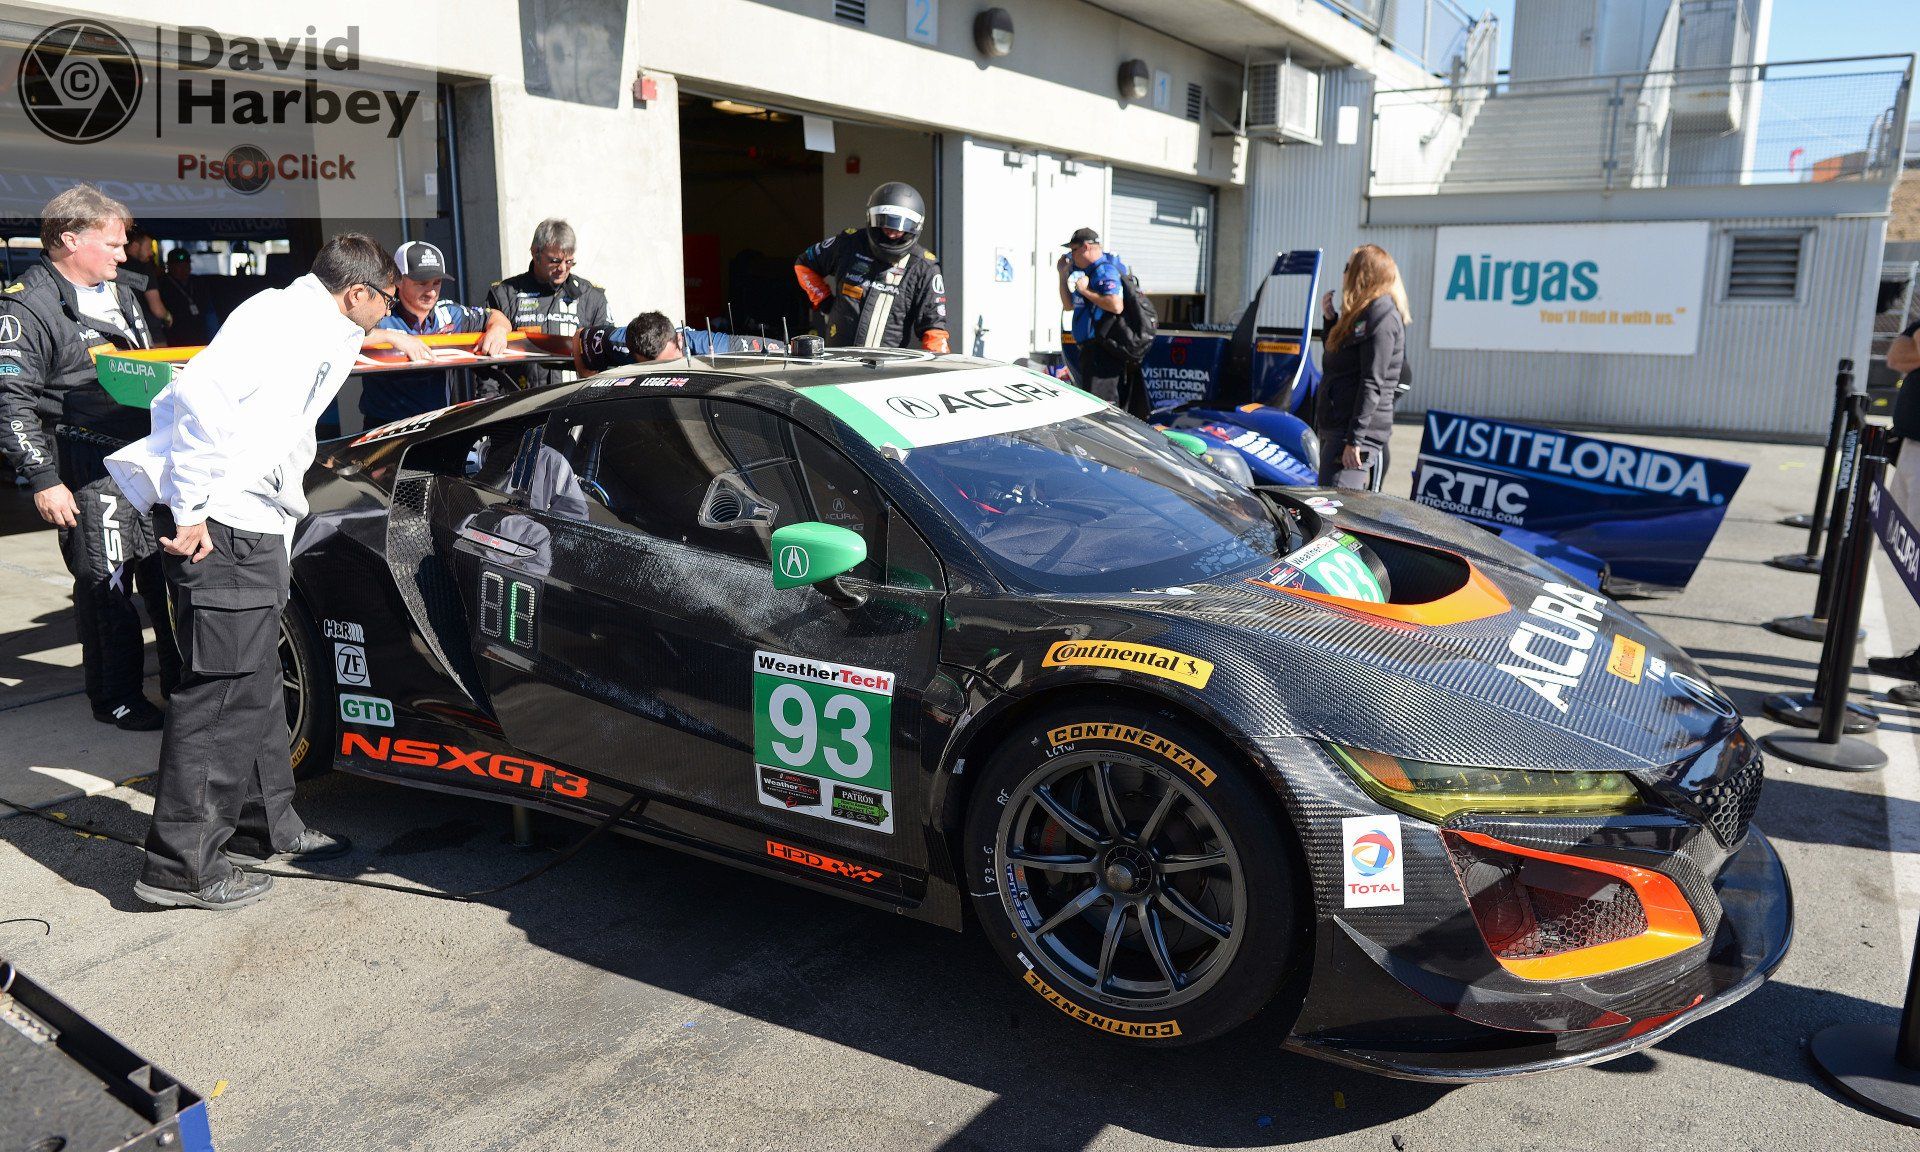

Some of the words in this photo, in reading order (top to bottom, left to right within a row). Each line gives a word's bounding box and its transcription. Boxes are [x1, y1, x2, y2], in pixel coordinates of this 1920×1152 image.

[914, 0, 931, 36] 2
[1160, 78, 1167, 96] 1
[1446, 254, 1600, 306] Airgas
[546, 313, 580, 325] ACURA
[1579, 310, 1606, 325] find
[1609, 310, 1620, 324] it
[1622, 310, 1652, 325] with
[117, 360, 156, 378] ACURA
[1141, 367, 1210, 382] VISITFLORIDA
[1145, 379, 1206, 393] VISITFLORIDA
[938, 383, 1062, 414] ACURA
[1416, 464, 1530, 515] RTIC
[825, 512, 858, 521] ACURA
[99, 493, 125, 596] NSX
[1318, 552, 1386, 604] 93
[1053, 643, 1179, 672] Continental
[1496, 582, 1608, 714] ACURA
[338, 653, 364, 675] ZF
[758, 655, 890, 691] WeatherTech
[343, 699, 391, 721] GTD
[768, 683, 874, 779] 93
[1053, 724, 1210, 782] CONTINENTAL
[763, 777, 819, 795] WeatherTech
[997, 788, 1009, 806] RF
[770, 843, 823, 867] HPD
[1347, 881, 1401, 896] TOTAL
[1030, 973, 1175, 1037] CONTINENTAL
